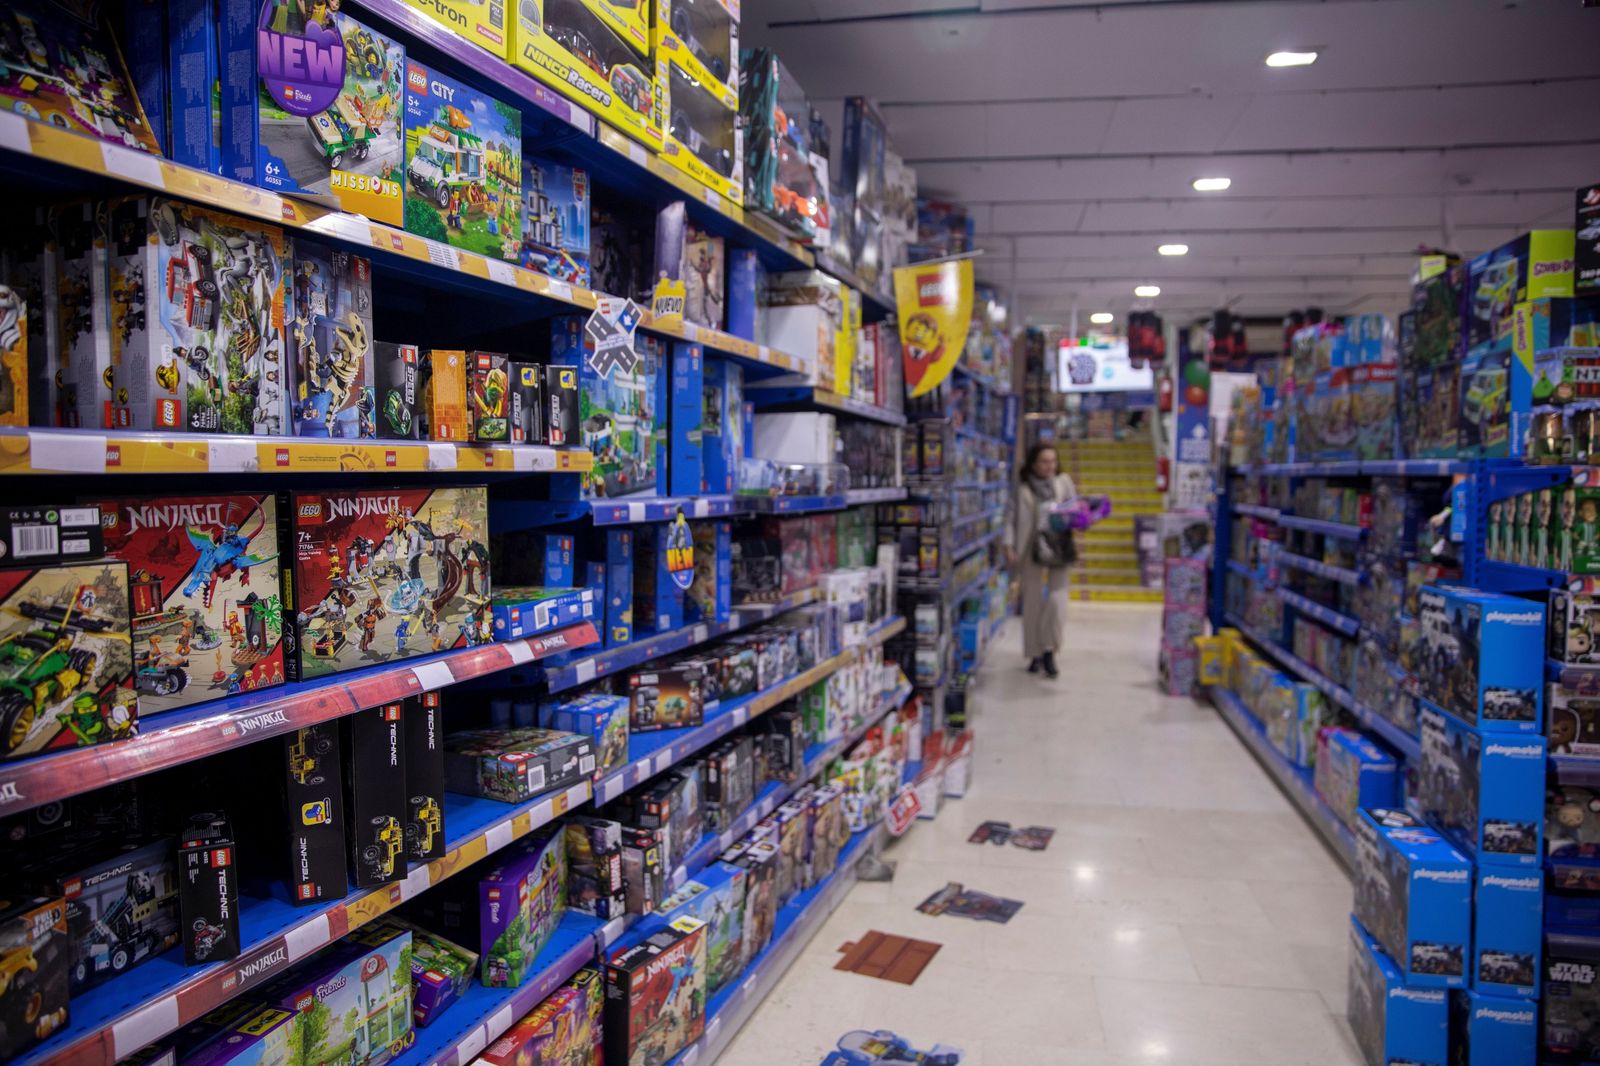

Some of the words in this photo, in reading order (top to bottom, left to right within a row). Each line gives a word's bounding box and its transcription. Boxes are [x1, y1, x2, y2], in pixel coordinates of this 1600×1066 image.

[259, 30, 343, 84] NEW
[408, 71, 428, 88] LEGO
[430, 80, 455, 102] CITY
[407, 95, 420, 107] 5+
[264, 161, 281, 175] 6+
[331, 172, 399, 197] MISSIONS
[405, 366, 415, 405] SPEED
[163, 400, 175, 427] LEGO
[192, 413, 200, 428] 6+
[102, 513, 117, 529] GO
[125, 503, 229, 536] NINJAGO
[299, 504, 321, 517] LEGO
[325, 496, 401, 523] NINJAGO
[298, 531, 312, 542] 7+
[1486, 610, 1542, 624] playmobil
[237, 709, 291, 736] NINJAGO
[427, 709, 435, 750] TECHNIC
[390, 723, 398, 767] TECHNIC
[1486, 743, 1543, 756] playmobil
[217, 849, 226, 867] LEGO
[300, 837, 309, 881] TECHNIC
[85, 862, 132, 887] TECHNIC
[1413, 867, 1469, 881] playmobil
[1482, 874, 1541, 888] playmobil
[218, 869, 229, 919] TECHNIC
[239, 946, 288, 985] NINJAGO
[1549, 966, 1596, 984] WARS
[1555, 962, 1593, 974] STAR
[296, 994, 313, 1011] LEGO
[316, 976, 346, 1003] Friends
[1389, 986, 1445, 1000] playmobil
[1476, 1007, 1534, 1022] playmobil
